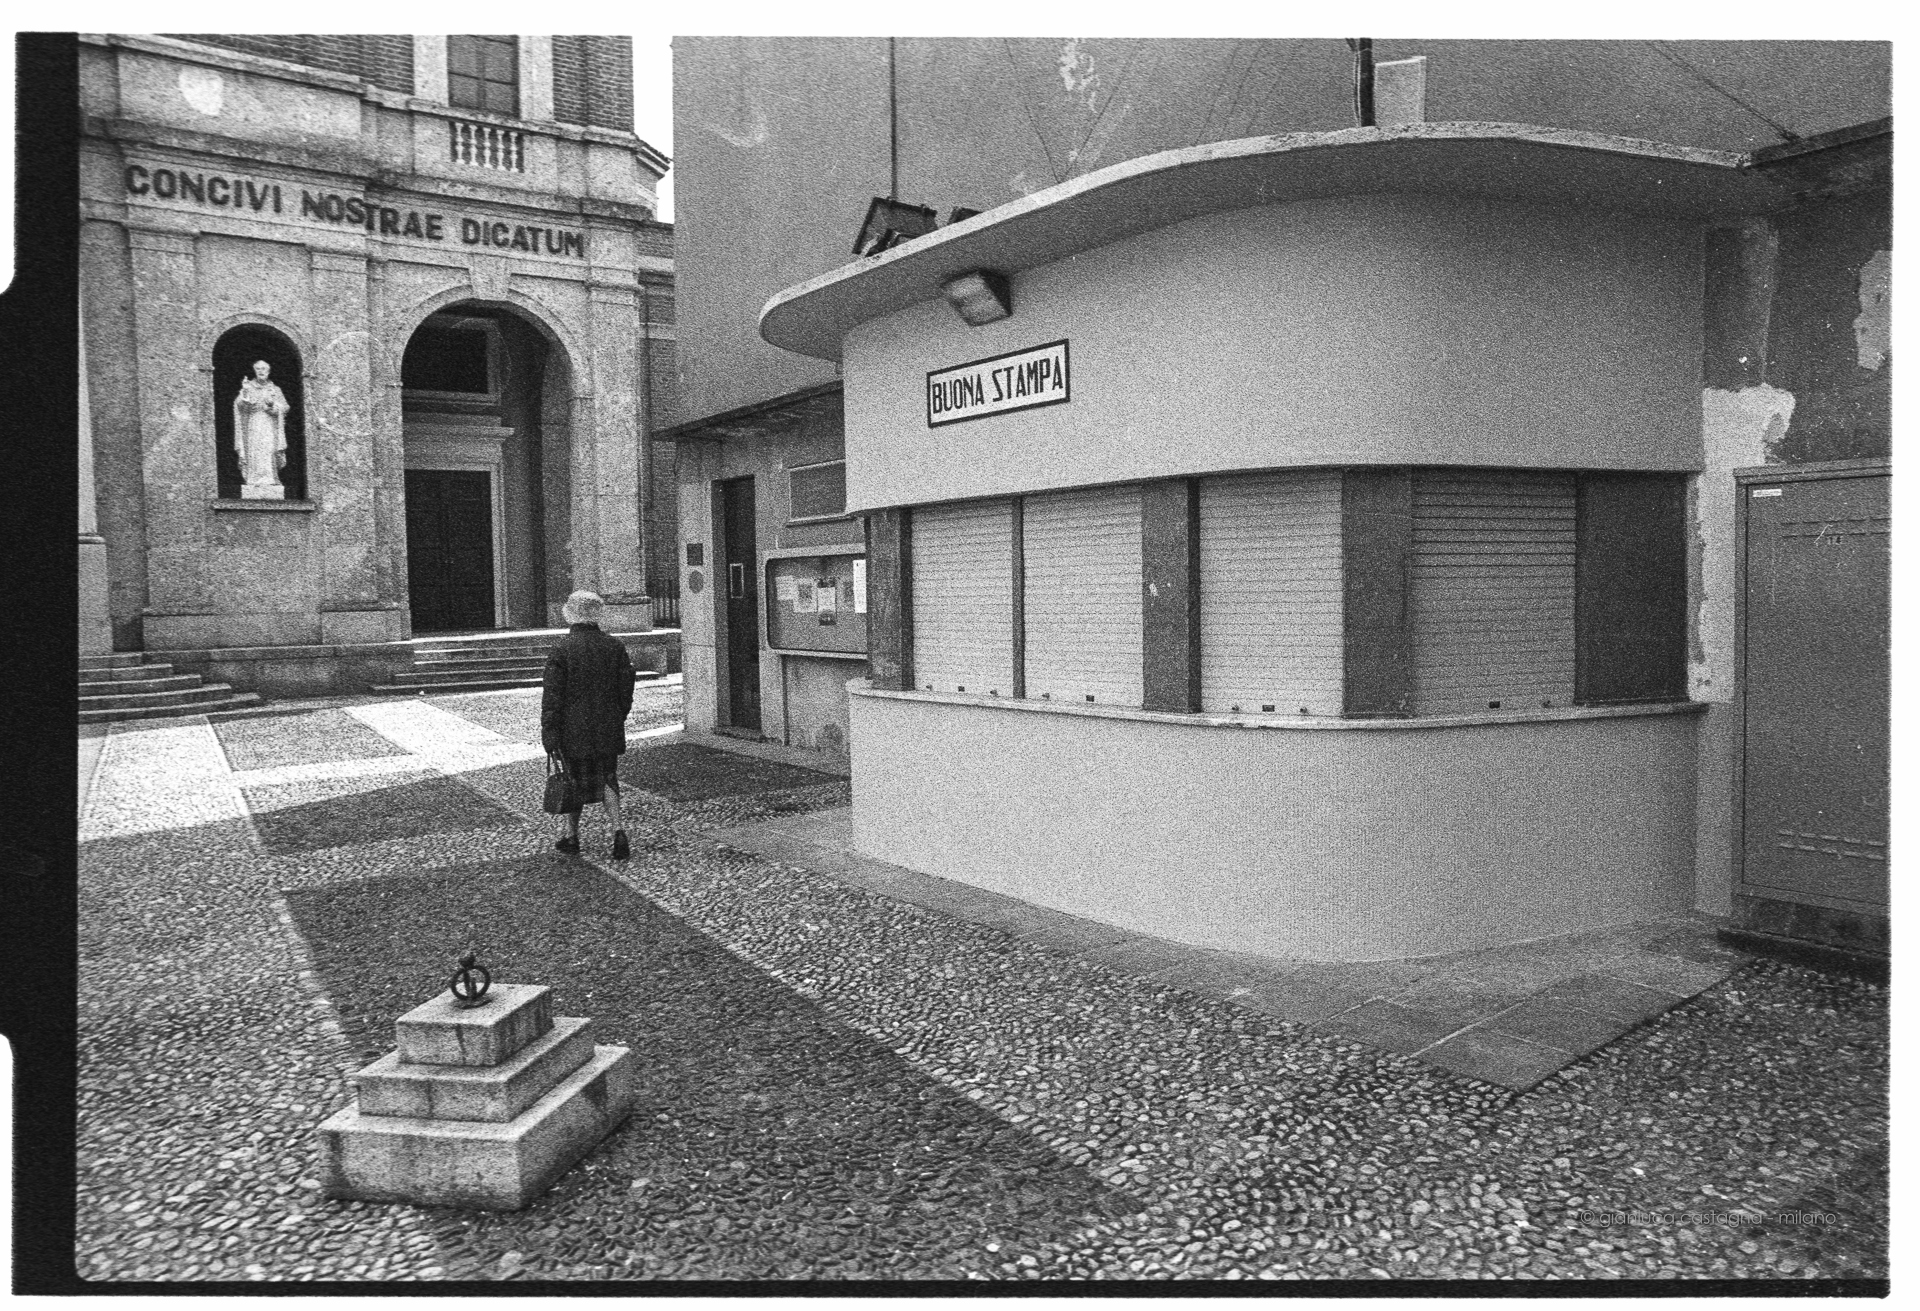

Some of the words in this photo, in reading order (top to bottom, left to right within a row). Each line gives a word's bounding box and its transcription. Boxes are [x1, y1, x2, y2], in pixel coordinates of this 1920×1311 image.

[125, 165, 282, 213] CONCIVI
[302, 190, 443, 240] NOSTRAE
[462, 218, 584, 258] DICATUM
[932, 374, 985, 414] BUONA
[992, 355, 1064, 402] STAMPA
